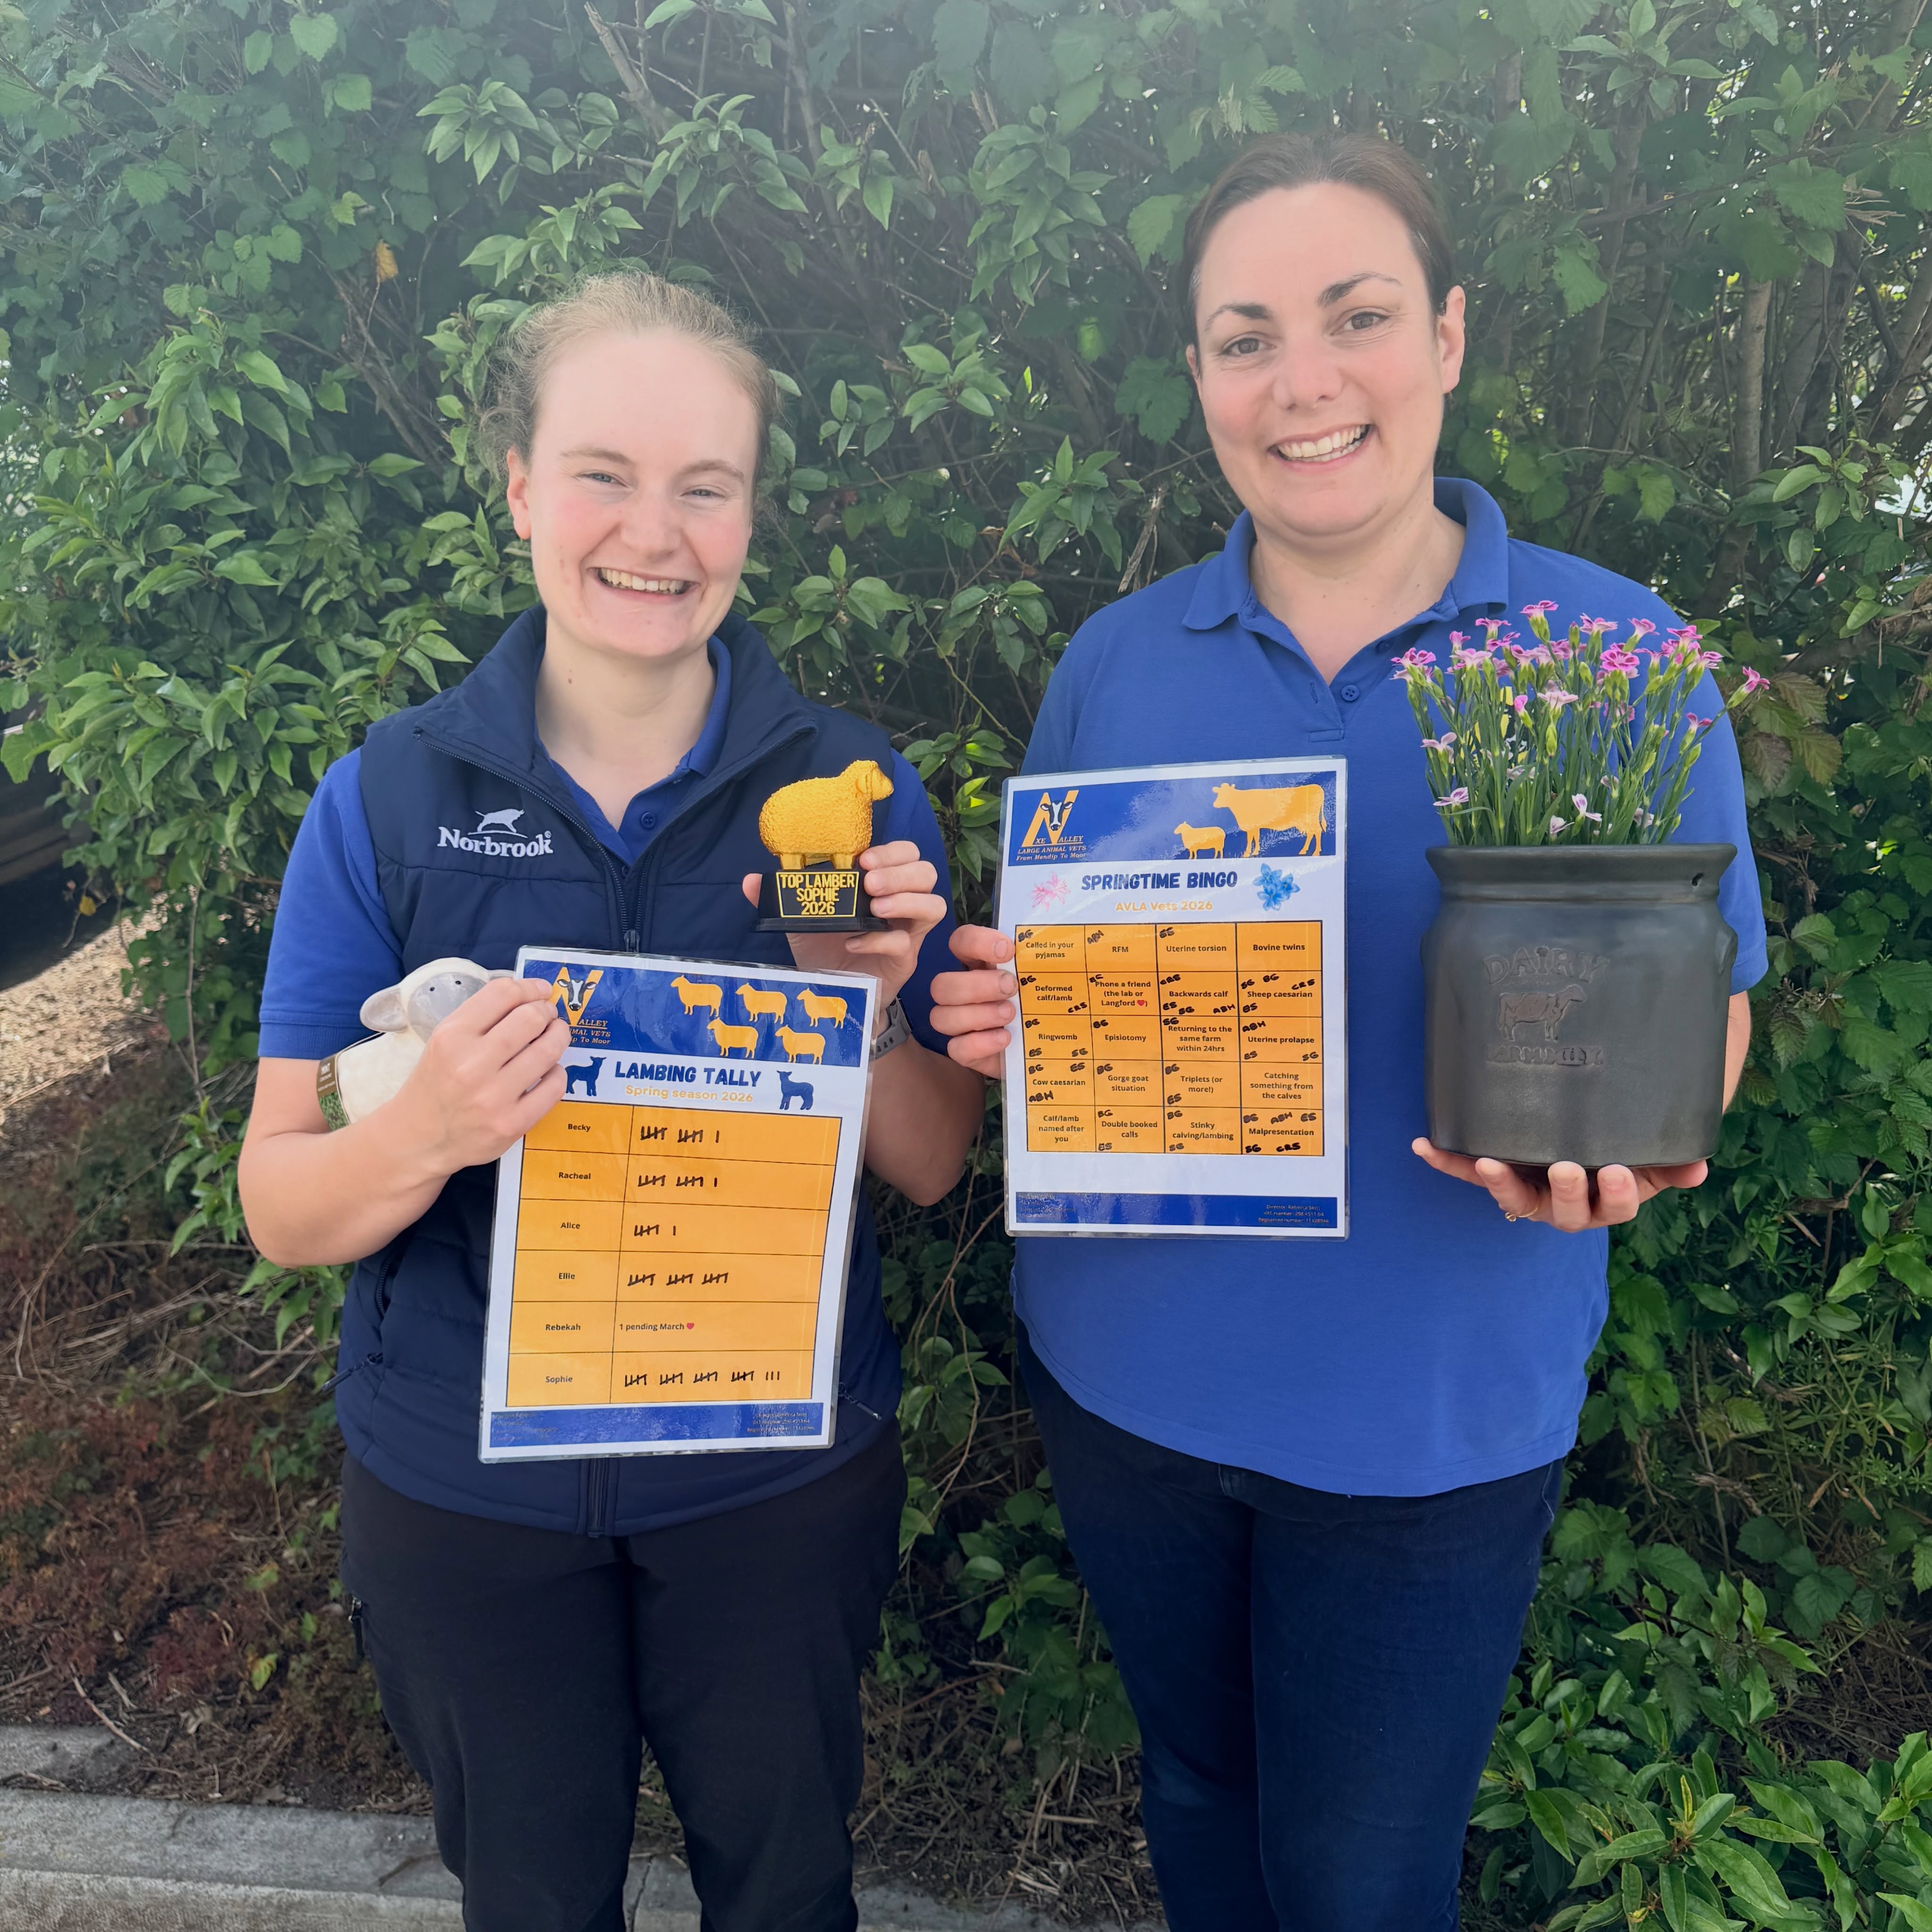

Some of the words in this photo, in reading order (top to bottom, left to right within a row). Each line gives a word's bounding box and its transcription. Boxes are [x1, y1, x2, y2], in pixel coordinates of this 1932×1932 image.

[780, 874, 804, 888] TOP
[806, 874, 854, 888] LAMBER
[1082, 873, 1180, 890] SPRINGTIME
[1187, 871, 1237, 888] BINGO
[797, 888, 839, 901] SOPHIE
[801, 902, 835, 915] 2026
[1116, 902, 1147, 911] AVLA
[1150, 902, 1177, 910] Vets
[1181, 901, 1212, 910] 2026
[1483, 947, 1610, 984] DAIRY
[615, 1061, 696, 1083] LAMBING
[704, 1067, 761, 1087] TALLY
[626, 1085, 668, 1099] Spring
[672, 1090, 717, 1100] season
[721, 1092, 753, 1102] 2026
[1098, 1110, 1113, 1118] BG
[568, 1124, 591, 1132] Becky
[1173, 1132, 1233, 1141] calving/lambing
[546, 1375, 573, 1383] Sophie
